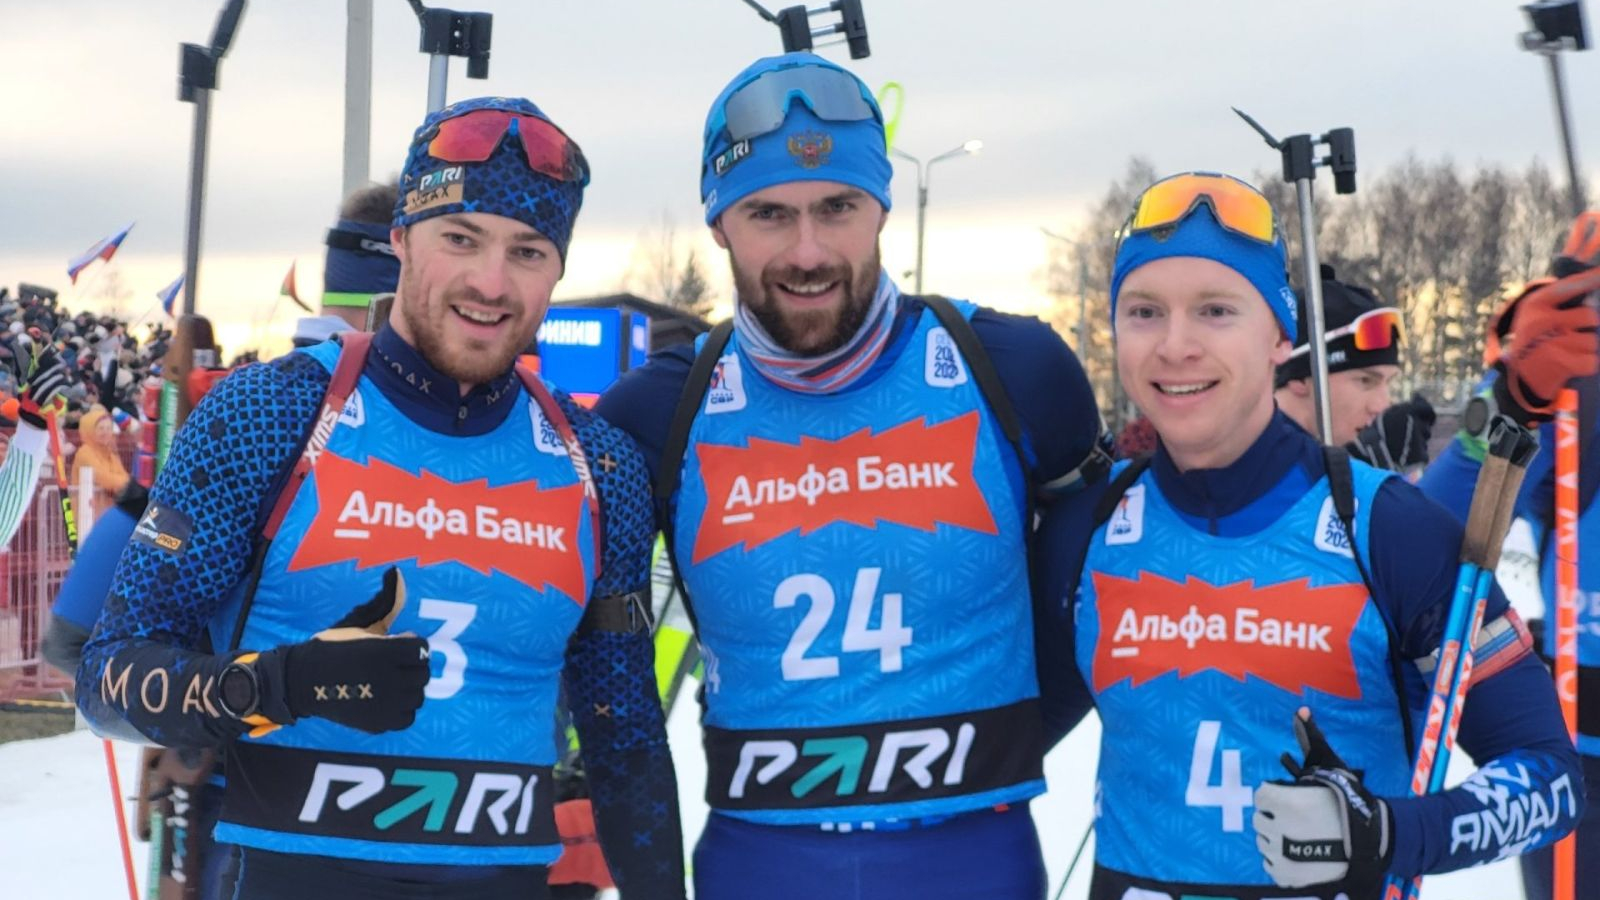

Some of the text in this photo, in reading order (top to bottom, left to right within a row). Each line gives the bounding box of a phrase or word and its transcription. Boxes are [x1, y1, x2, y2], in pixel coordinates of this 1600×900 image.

[420, 165, 462, 191] PARI
[716, 139, 749, 174] PARI
[723, 456, 958, 513] Альфа Банк
[334, 489, 567, 552] Альфа Банк
[418, 598, 478, 700] 3
[774, 567, 913, 681] 24
[1112, 605, 1332, 653] Альфа Банк
[729, 722, 976, 798] PARI
[1185, 720, 1254, 832] 4
[298, 762, 538, 835] PARI
[1289, 844, 1332, 857] MOAX
